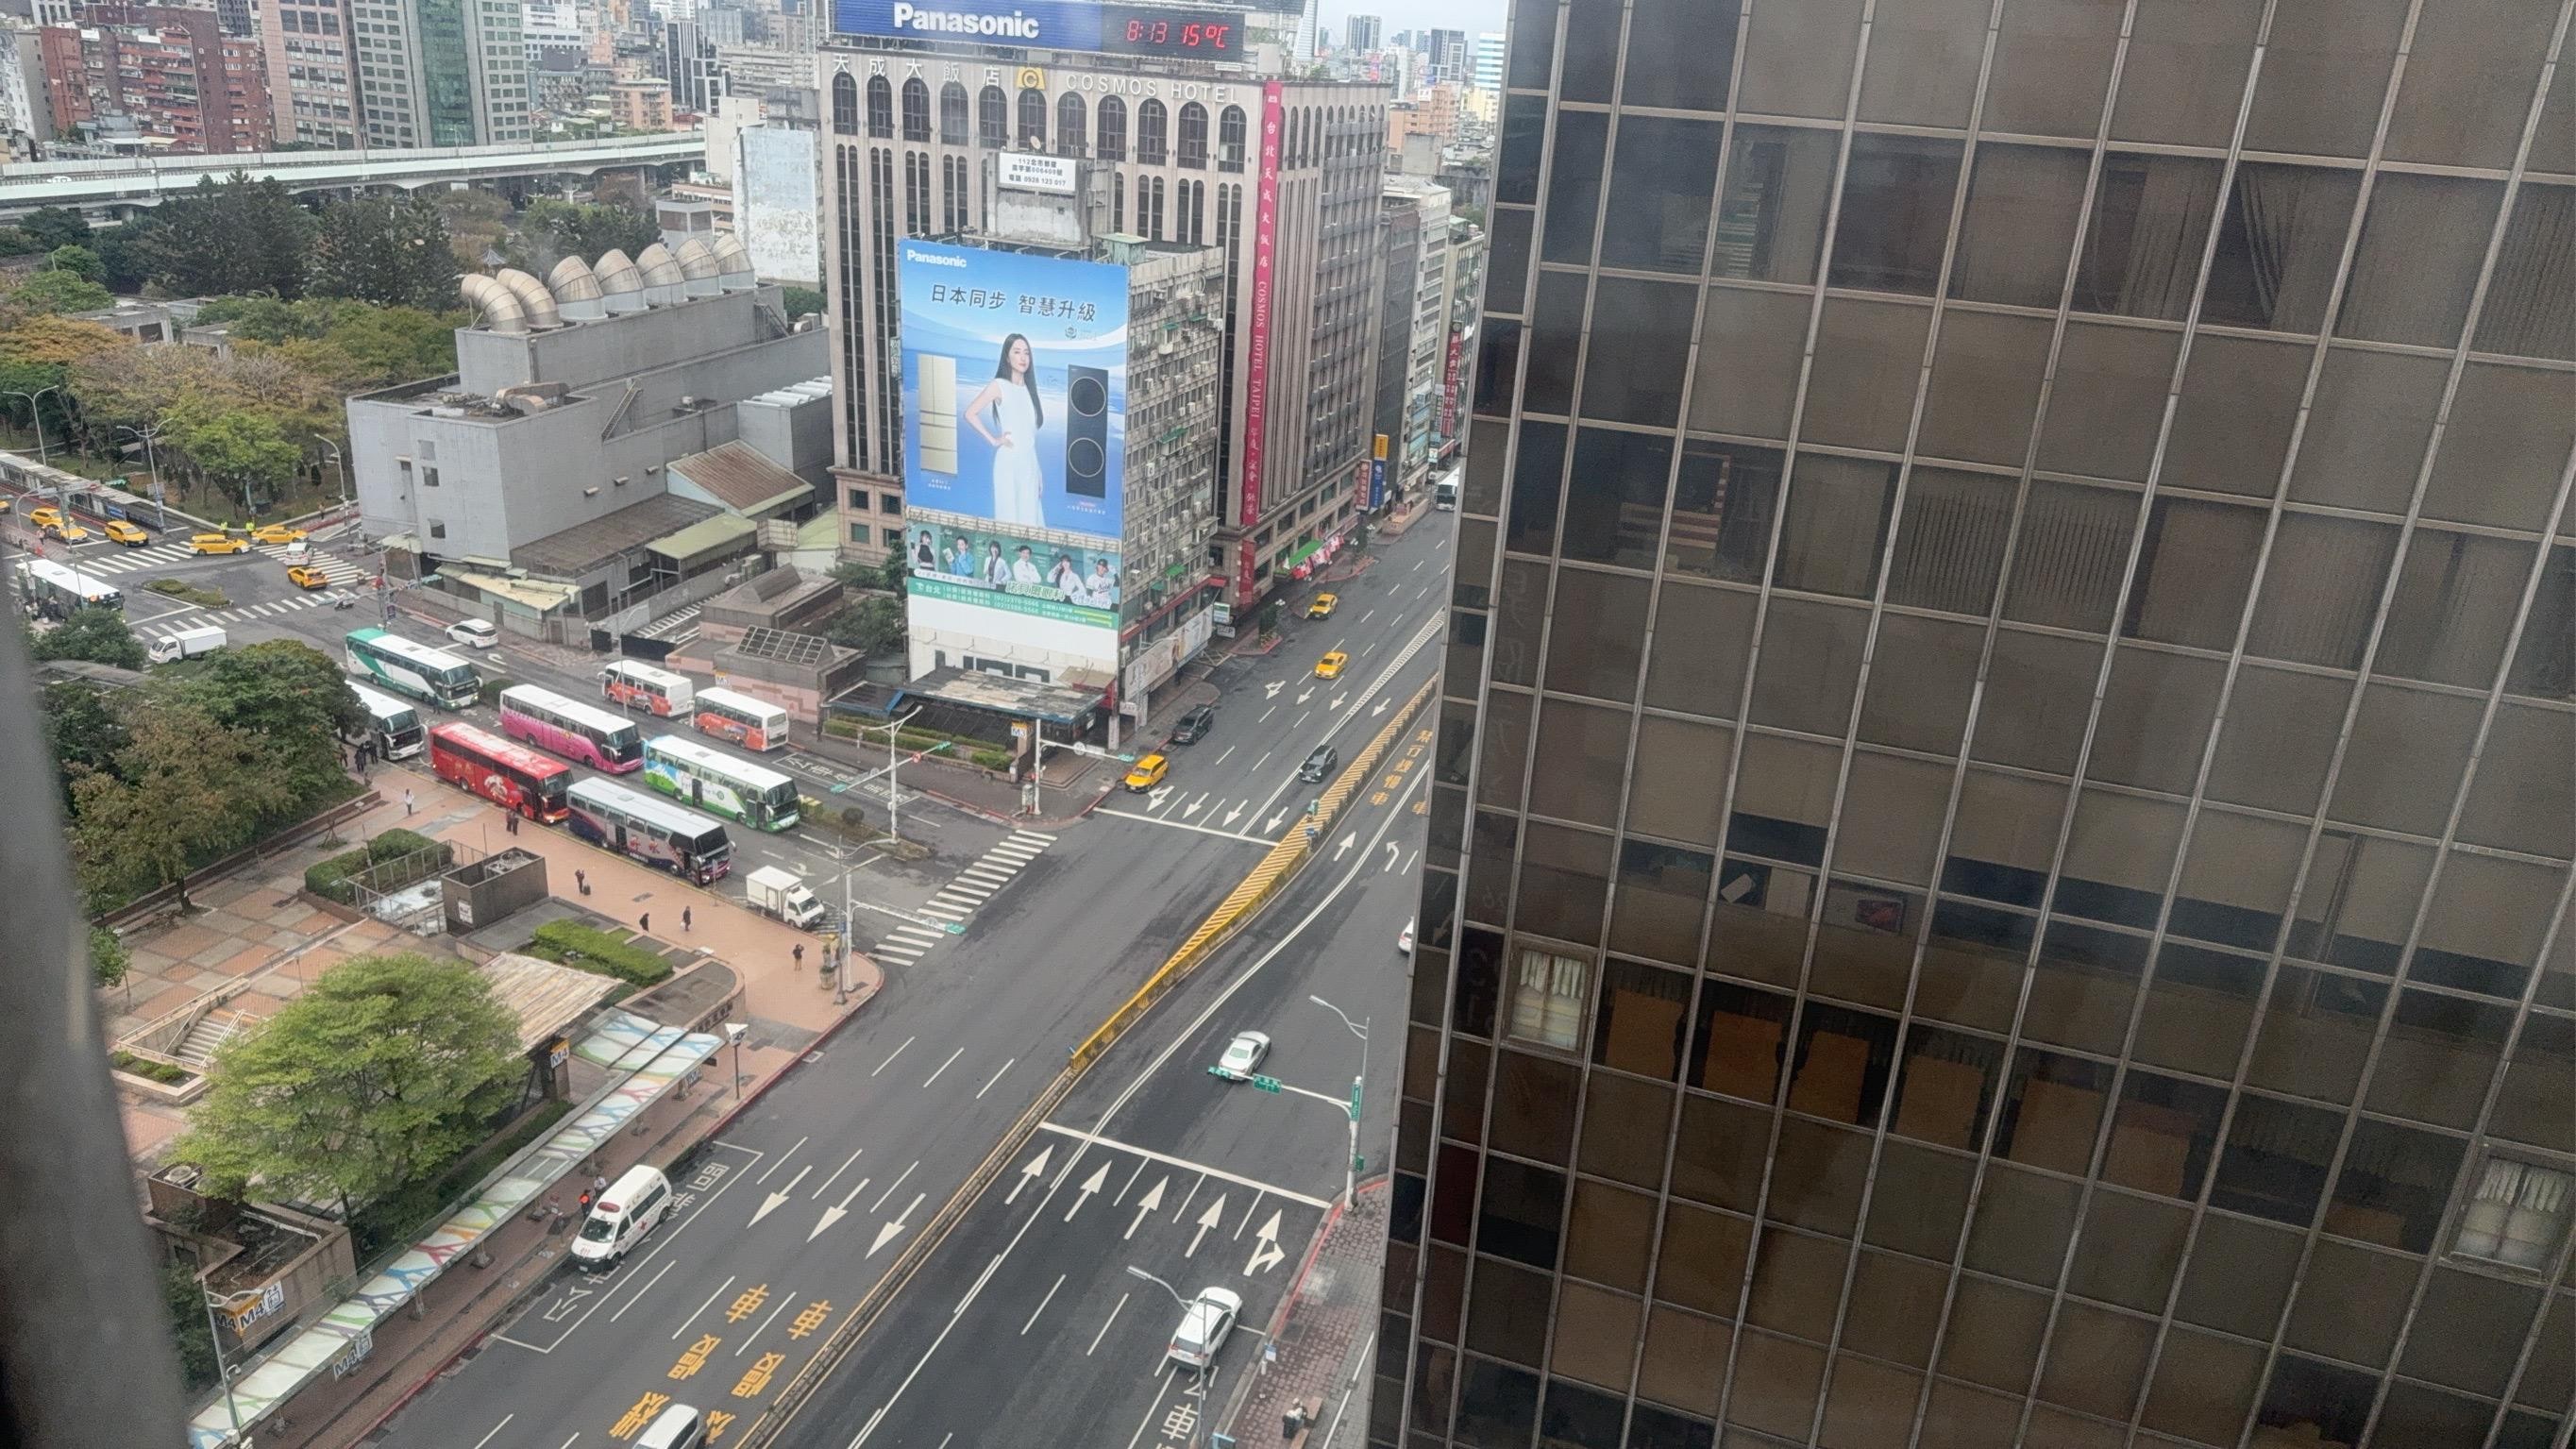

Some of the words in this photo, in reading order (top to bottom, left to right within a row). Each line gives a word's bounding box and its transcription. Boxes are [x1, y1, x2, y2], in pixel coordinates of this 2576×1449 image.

[894, 2, 1039, 39] Panasonic
[1127, 20, 1168, 43] 8:13
[833, 53, 1001, 87] 天成大飯店
[1067, 74, 1156, 96] COSMOS
[1171, 83, 1238, 104] HOTEL
[907, 249, 967, 268] Panasonic
[932, 284, 1006, 310] 日本同步
[1019, 294, 1096, 322] 智慧升級
[1255, 280, 1267, 329] COSMOS
[1254, 335, 1264, 372] HOTEL
[1251, 379, 1262, 418] TAIPEI
[240, 1302, 264, 1330] M4
